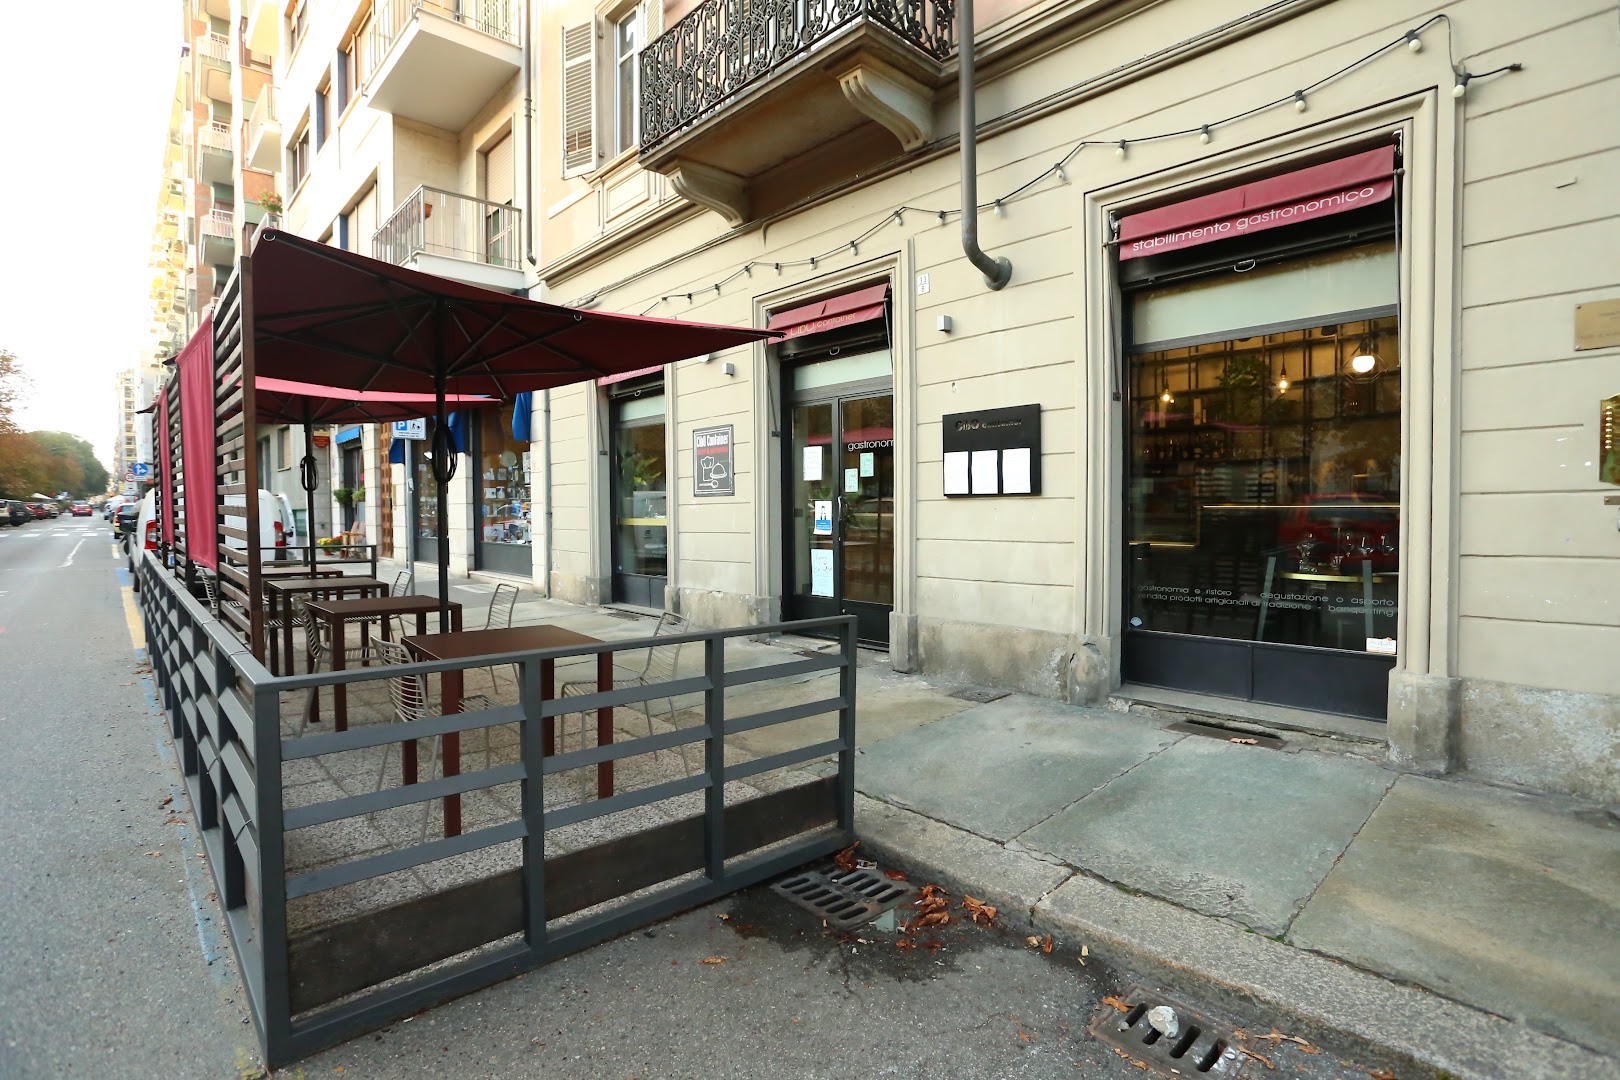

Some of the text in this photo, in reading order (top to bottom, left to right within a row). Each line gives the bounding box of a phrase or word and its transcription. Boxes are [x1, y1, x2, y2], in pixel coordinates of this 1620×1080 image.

[1132, 187, 1374, 252] stabilimento gastronomico
[816, 312, 856, 328] container
[1137, 585, 1189, 594] gastronomia
[1205, 588, 1232, 596] ristoro
[1260, 591, 1329, 603] degustazione
[1350, 597, 1395, 607] asporto
[1137, 593, 1168, 601] vendita
[1169, 594, 1203, 603] prodotti
[1204, 596, 1249, 606] artigianali
[1251, 599, 1261, 607] di
[1262, 600, 1312, 611] tradizione
[1328, 604, 1394, 617] banqueting
